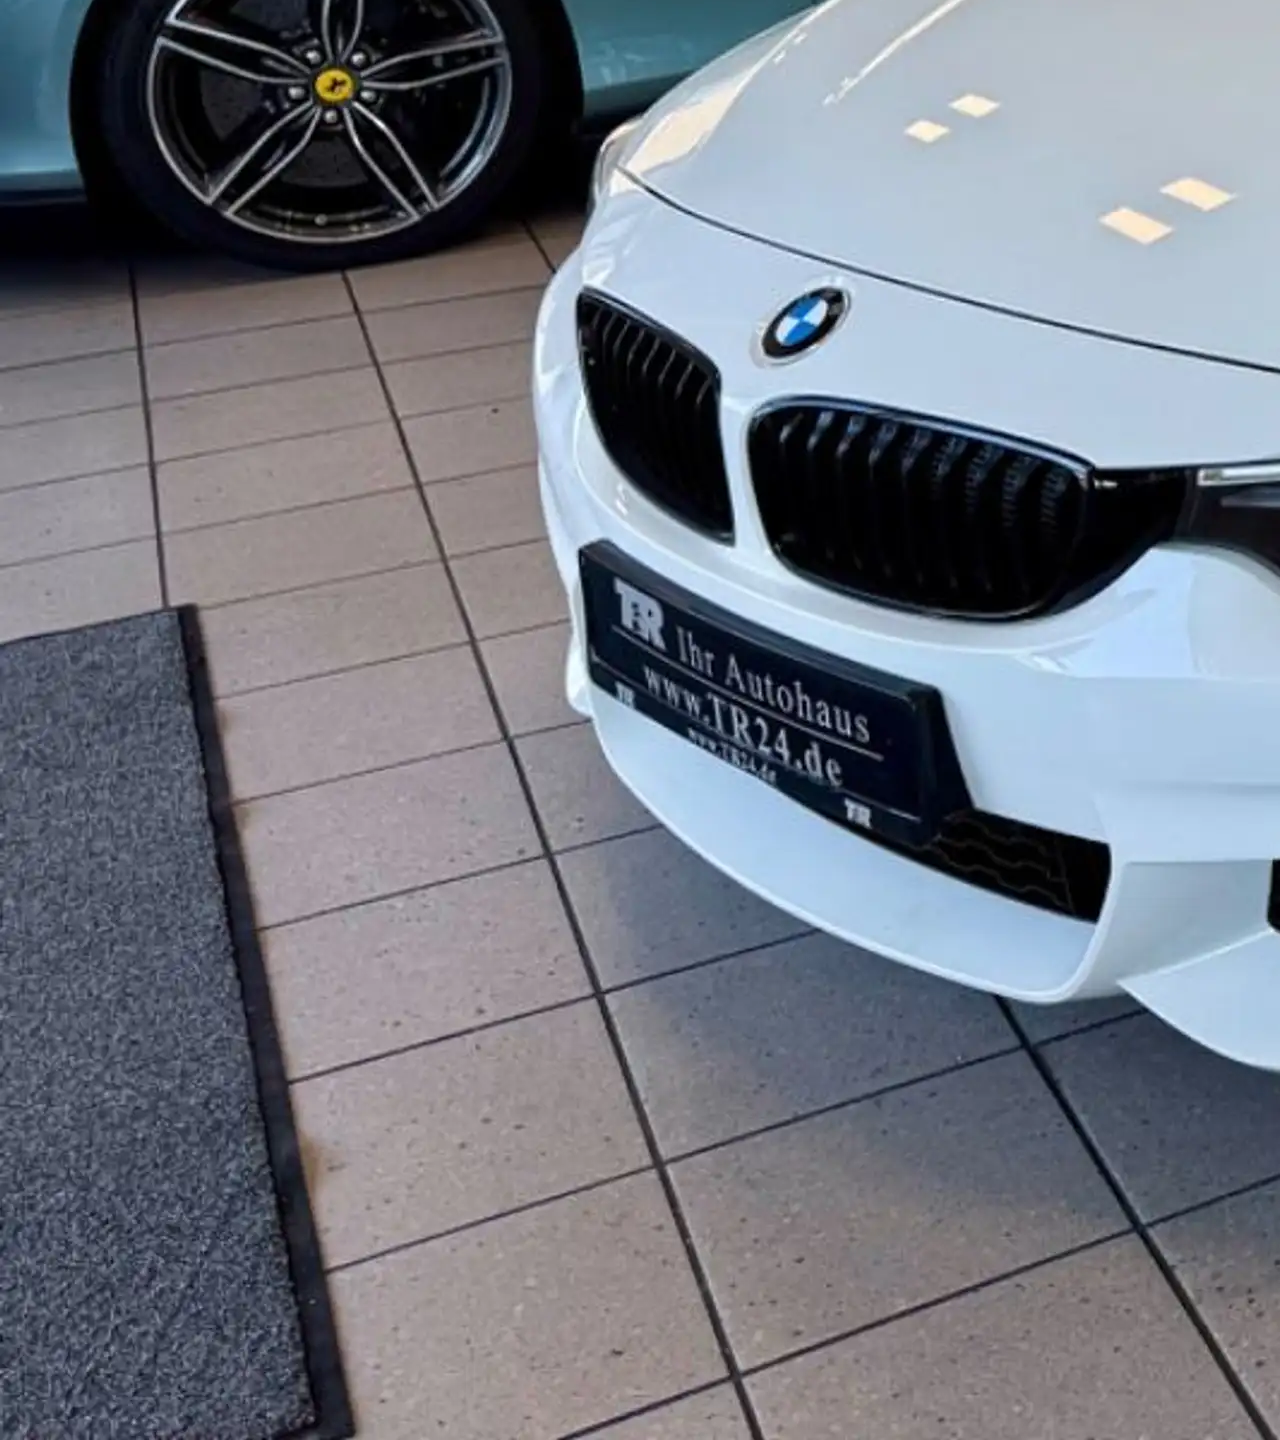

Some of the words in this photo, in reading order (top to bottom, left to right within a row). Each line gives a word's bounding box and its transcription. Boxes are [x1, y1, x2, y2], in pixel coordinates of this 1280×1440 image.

[643, 664, 844, 788] www.TR24.de
[675, 626, 715, 677] Ihr
[724, 654, 871, 744] Autohaus
